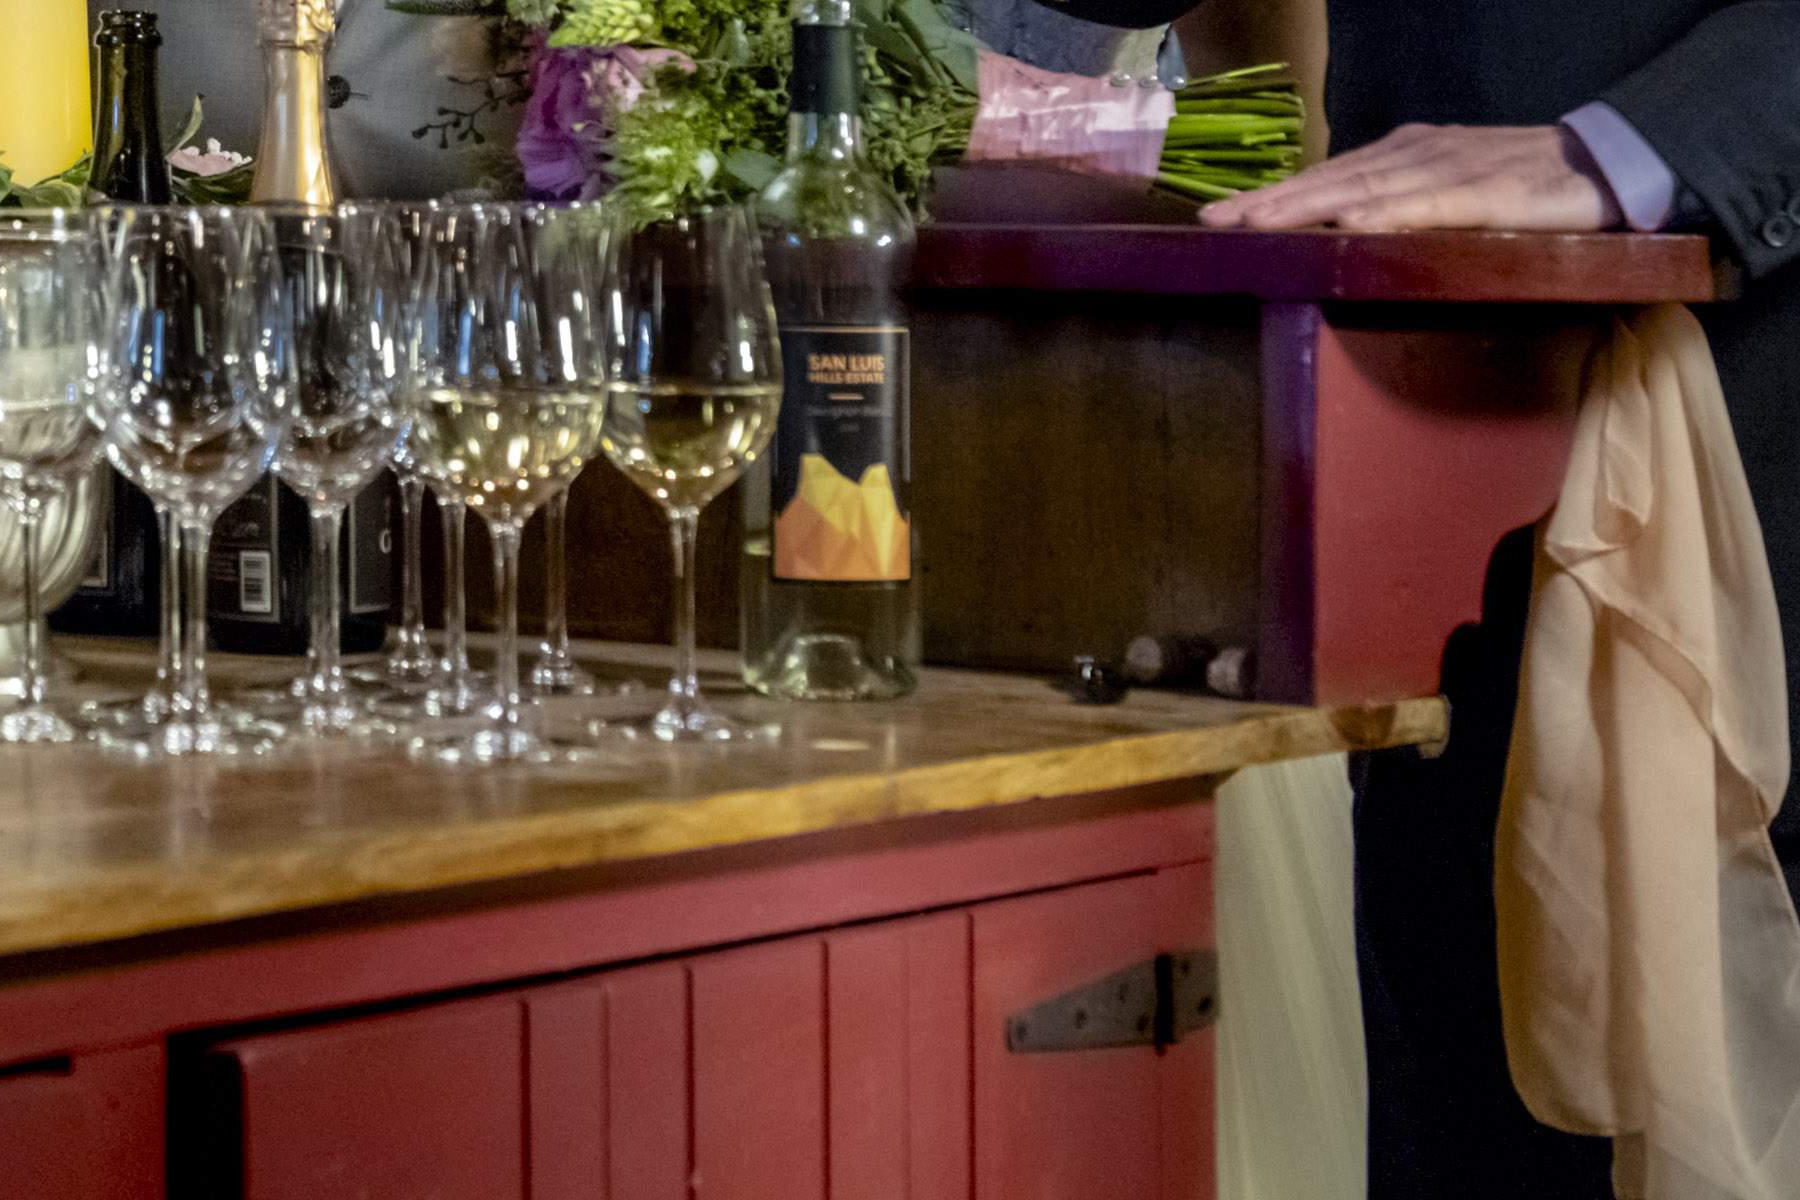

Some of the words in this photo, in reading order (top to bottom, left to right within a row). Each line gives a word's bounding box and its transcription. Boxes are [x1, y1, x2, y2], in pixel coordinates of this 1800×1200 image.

[808, 354, 847, 371] SAN
[850, 354, 885, 371] LUIS
[808, 373, 843, 384] HILLS
[845, 373, 884, 384] ESTATE
